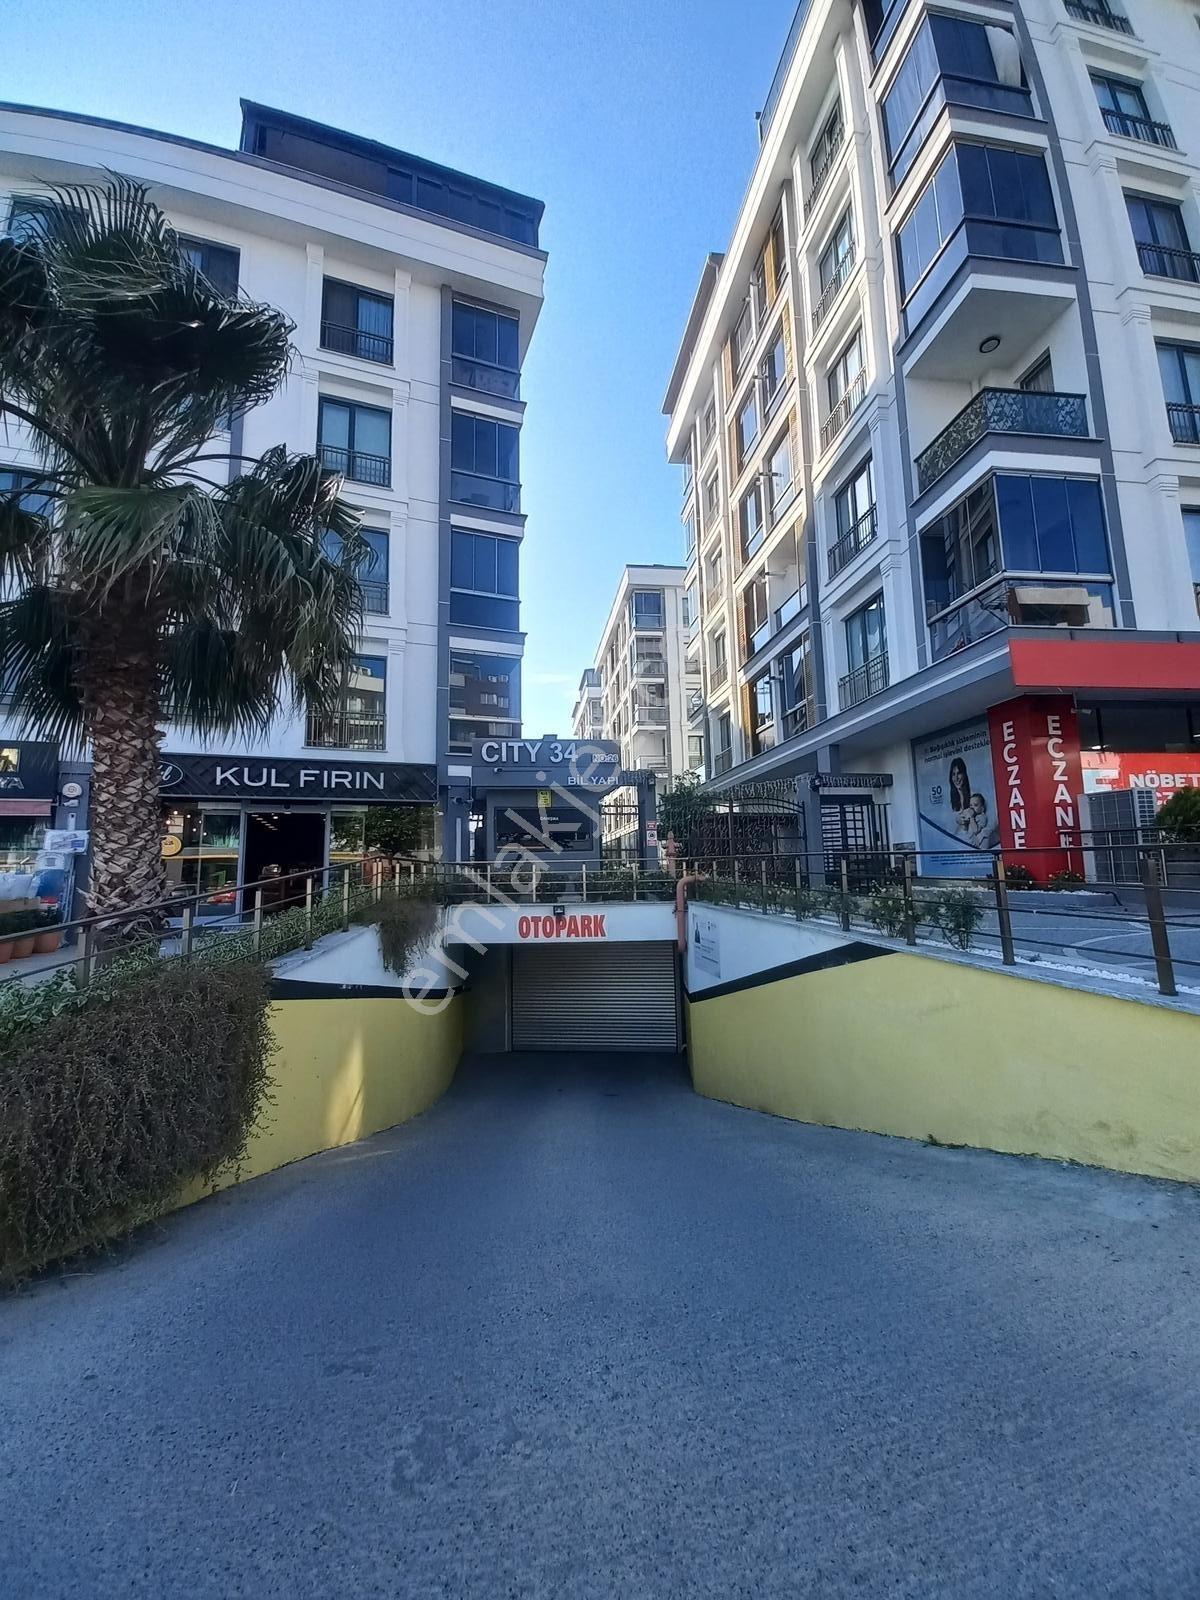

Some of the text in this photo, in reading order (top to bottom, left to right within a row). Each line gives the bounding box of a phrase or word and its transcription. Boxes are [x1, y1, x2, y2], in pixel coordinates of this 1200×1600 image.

[481, 741, 579, 763] CITY 34
[216, 766, 385, 790] KUL FIRIN
[567, 774, 619, 785] BİL YAPI
[1003, 721, 1027, 849] ECZANE
[1047, 715, 1074, 848] ECZANE
[1128, 769, 1200, 788] NÖBET
[931, 785, 942, 796] 50
[518, 914, 606, 939] OTOPARK
